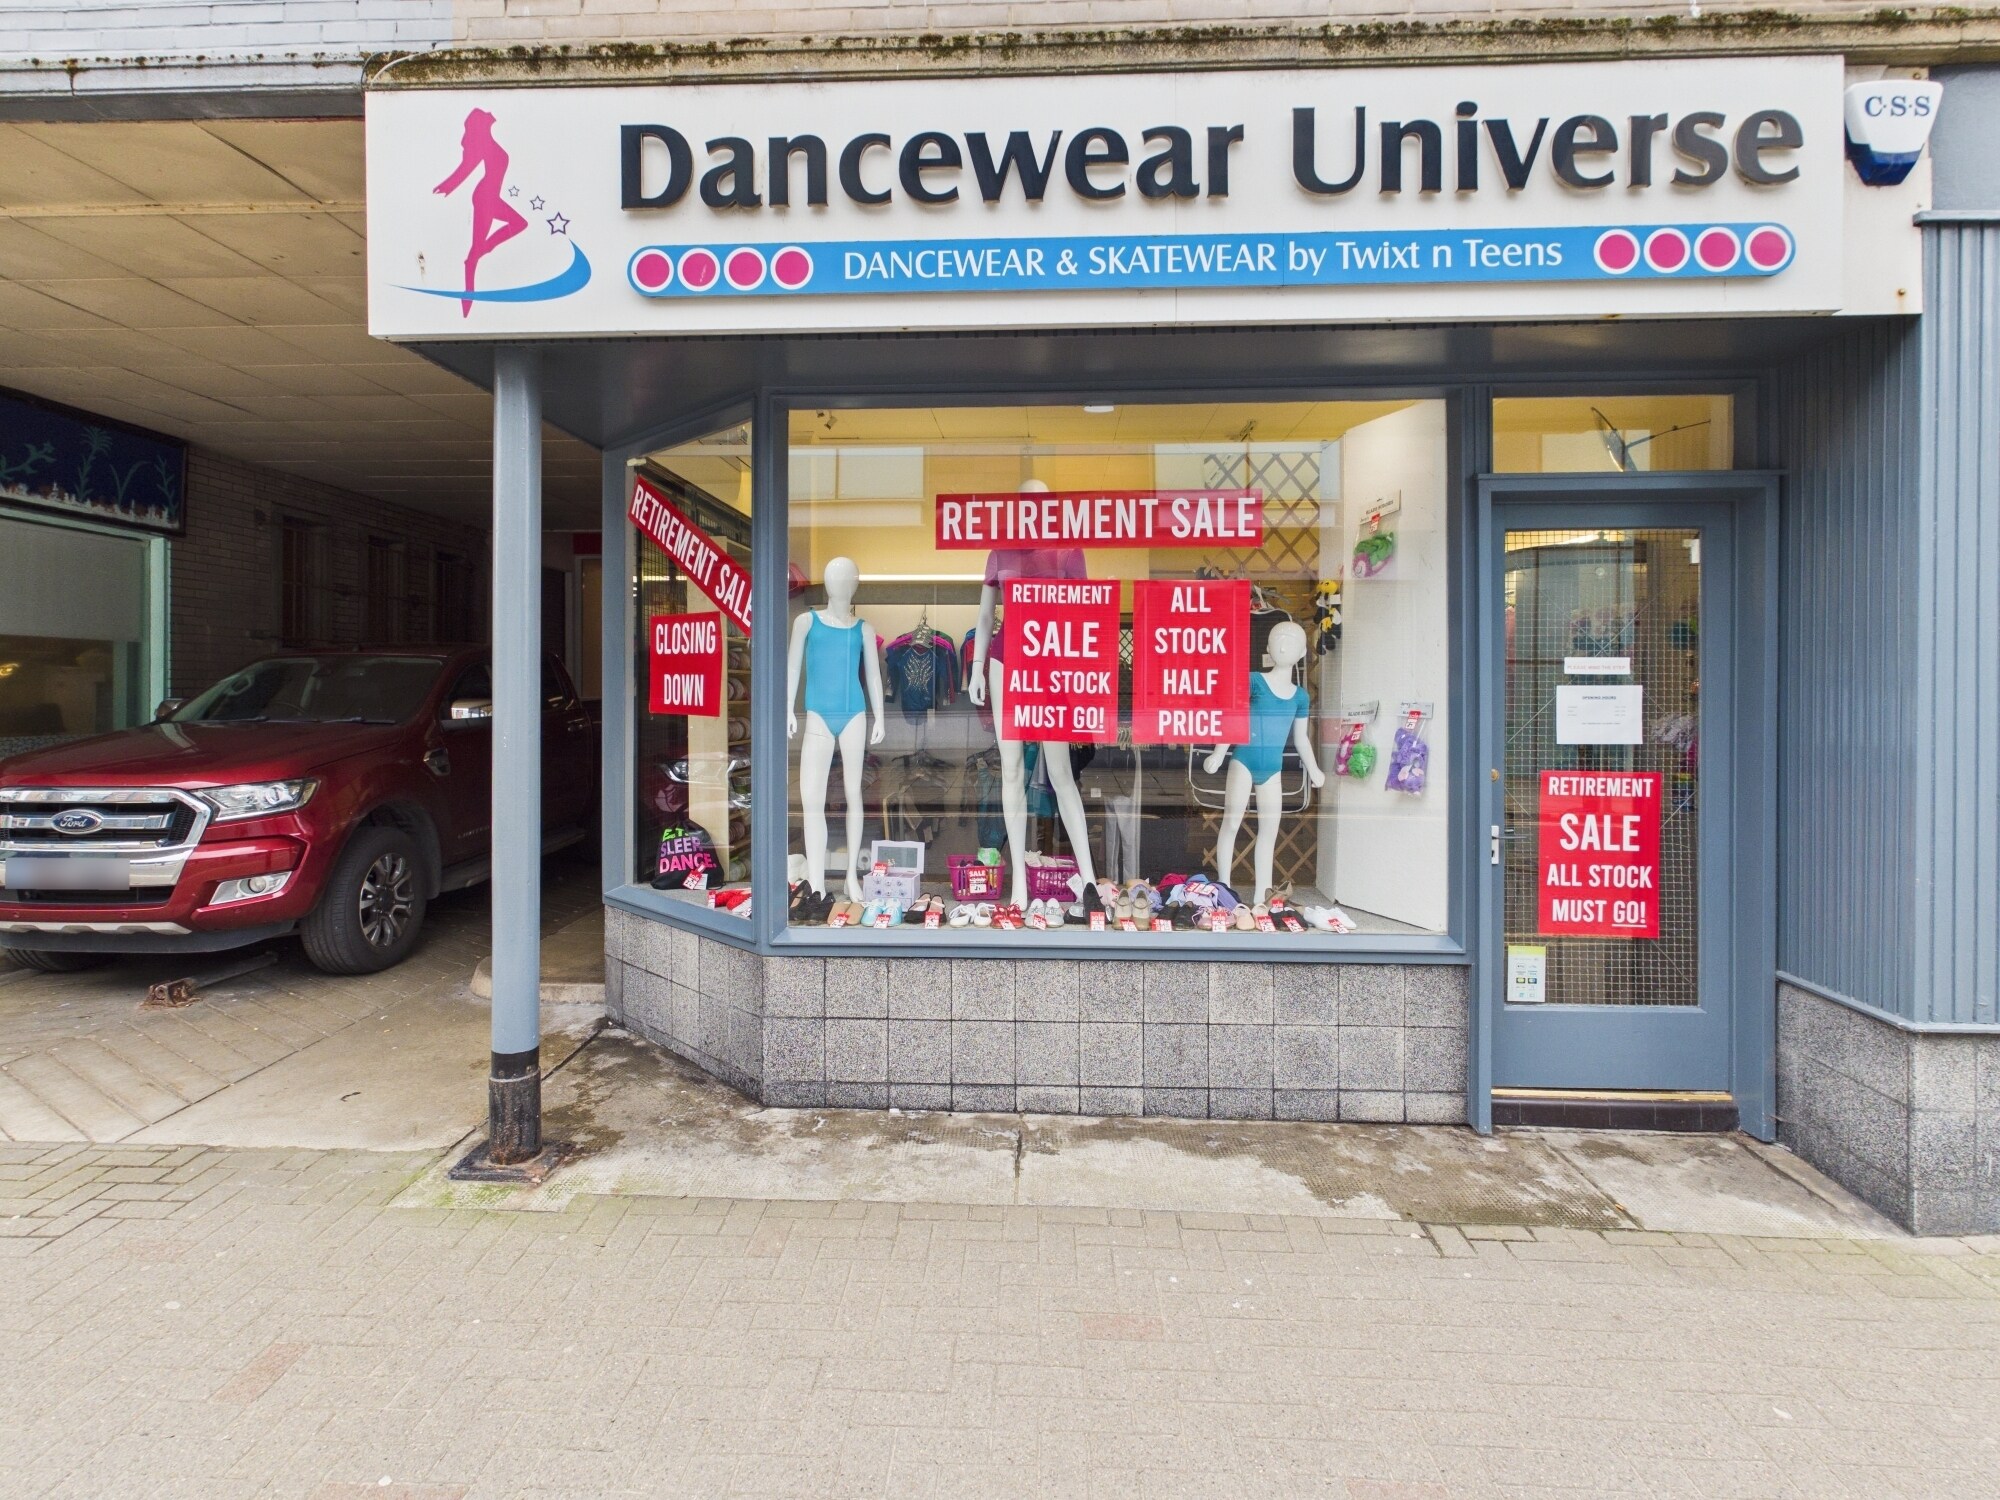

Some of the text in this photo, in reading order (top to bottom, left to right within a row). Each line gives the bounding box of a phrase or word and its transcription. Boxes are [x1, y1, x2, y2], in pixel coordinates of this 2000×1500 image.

[620, 101, 1803, 211] Dancewear Universe
[844, 239, 1563, 280] DANCEWEAR & SKATEWEAR by Twixt n Teens
[942, 497, 1256, 540] RETIREMENT SALE
[631, 484, 752, 628] RETIREMENT SALE
[1012, 584, 1113, 605] RETIREMENT
[1170, 587, 1211, 613] ALL
[655, 620, 716, 655] CLOSING
[1022, 620, 1100, 658] SALE
[1154, 627, 1227, 654] STOCK
[663, 673, 704, 707] DOWN
[1009, 669, 1111, 695] ALL STOCK
[1163, 669, 1219, 695] HALF
[1013, 705, 1105, 731] MUST GO!
[1158, 709, 1223, 737] PRICE
[1548, 776, 1654, 798] RETIREMENT
[60, 815, 87, 828] Ford
[1559, 813, 1641, 852] SALE
[1546, 863, 1653, 889] ALL STOCK
[1552, 898, 1646, 926] MUST GO!
